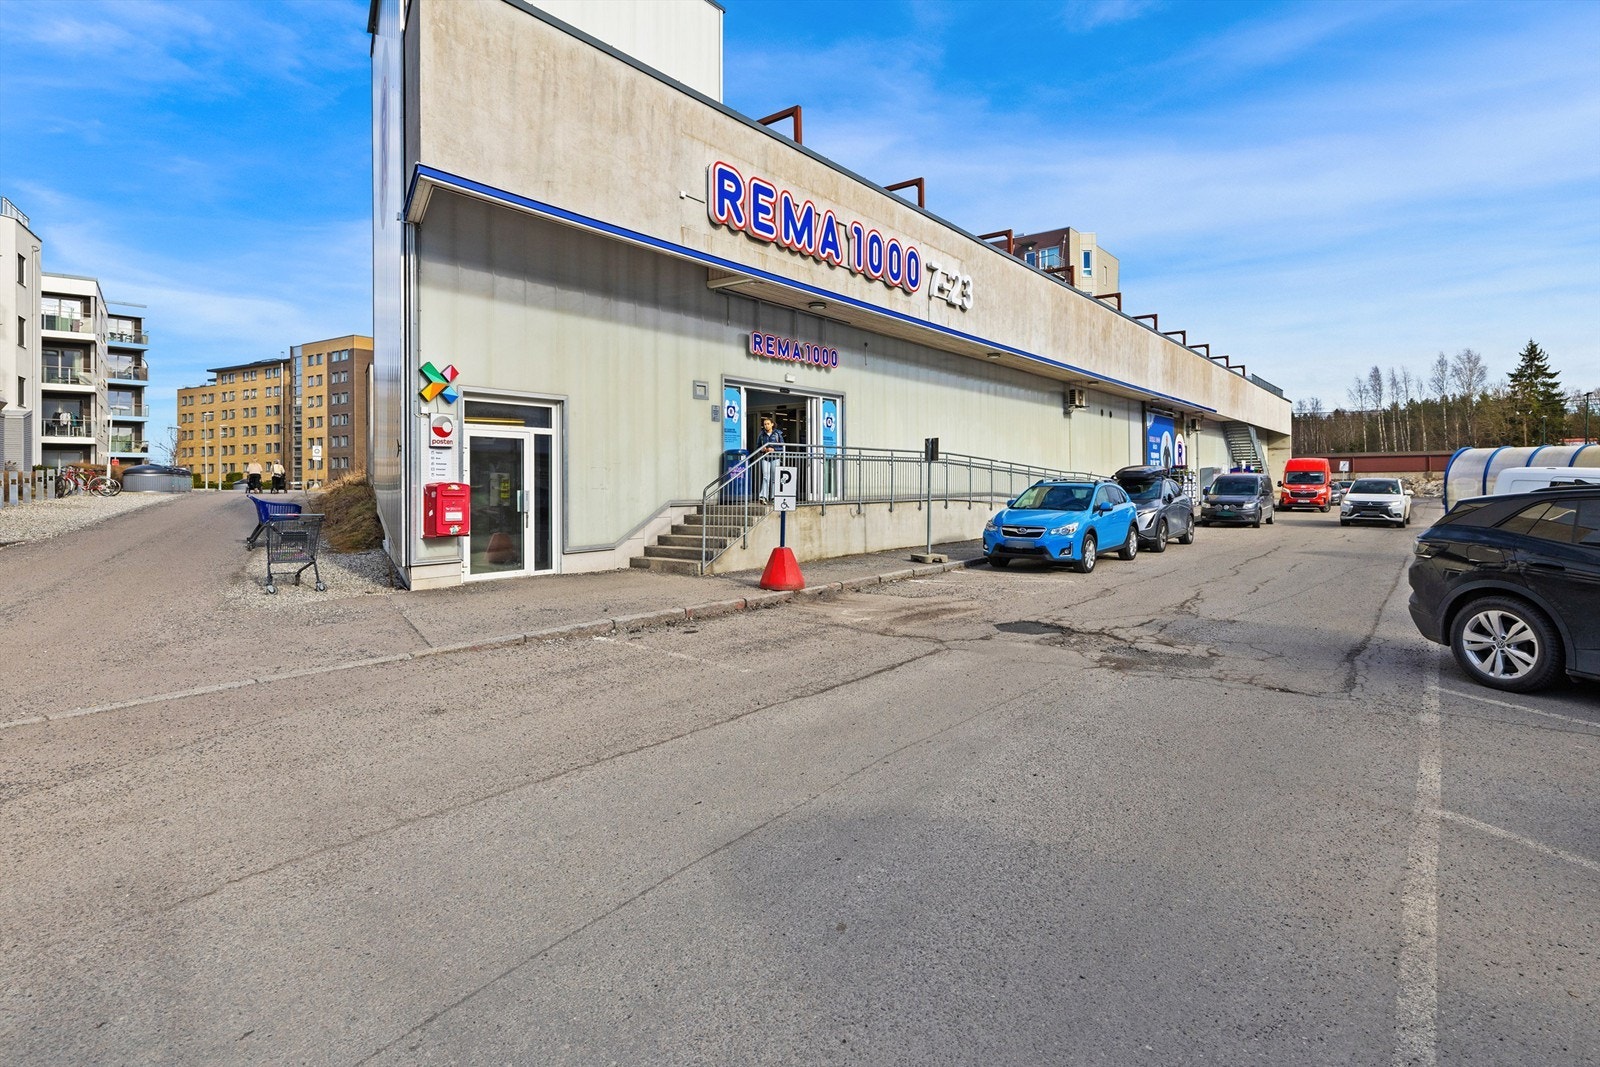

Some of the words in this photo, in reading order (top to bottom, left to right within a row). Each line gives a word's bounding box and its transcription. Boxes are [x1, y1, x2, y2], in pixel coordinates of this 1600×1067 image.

[710, 161, 843, 266] REMA
[849, 220, 921, 292] 1000
[752, 331, 802, 362] REMA
[804, 342, 839, 368] 1000
[431, 438, 454, 446] posten
[780, 470, 792, 492] P
